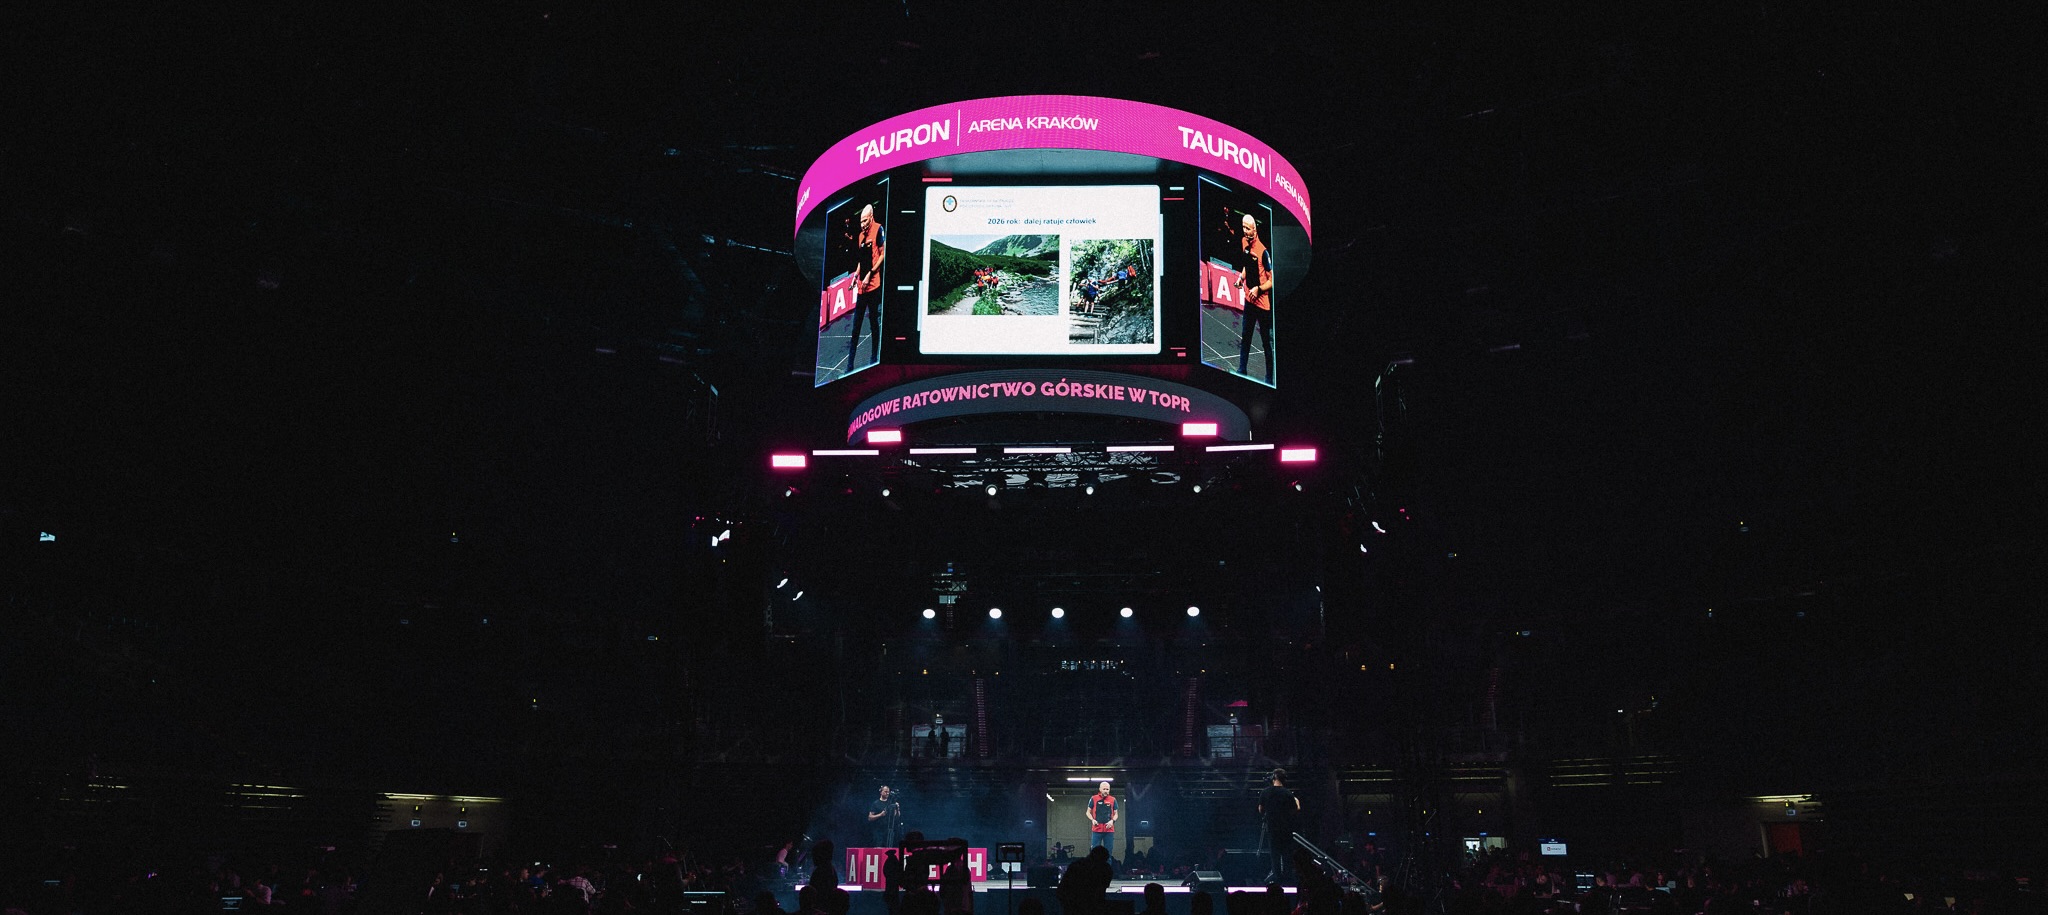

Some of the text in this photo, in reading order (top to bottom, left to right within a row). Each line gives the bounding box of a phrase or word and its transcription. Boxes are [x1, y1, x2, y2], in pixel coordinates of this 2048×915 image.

[856, 115, 1099, 165] TAURON ARENA KRAKÓW
[1177, 125, 1266, 179] TAURON
[1023, 217, 1042, 226] dalej
[1043, 218, 1064, 226] ratuje
[1065, 217, 1097, 225] człowiek
[902, 381, 1037, 411] RATOWNICTWO
[1040, 378, 1125, 401] GÓRSKIE
[1127, 387, 1147, 403] W
[1148, 390, 1191, 413] TOPR
